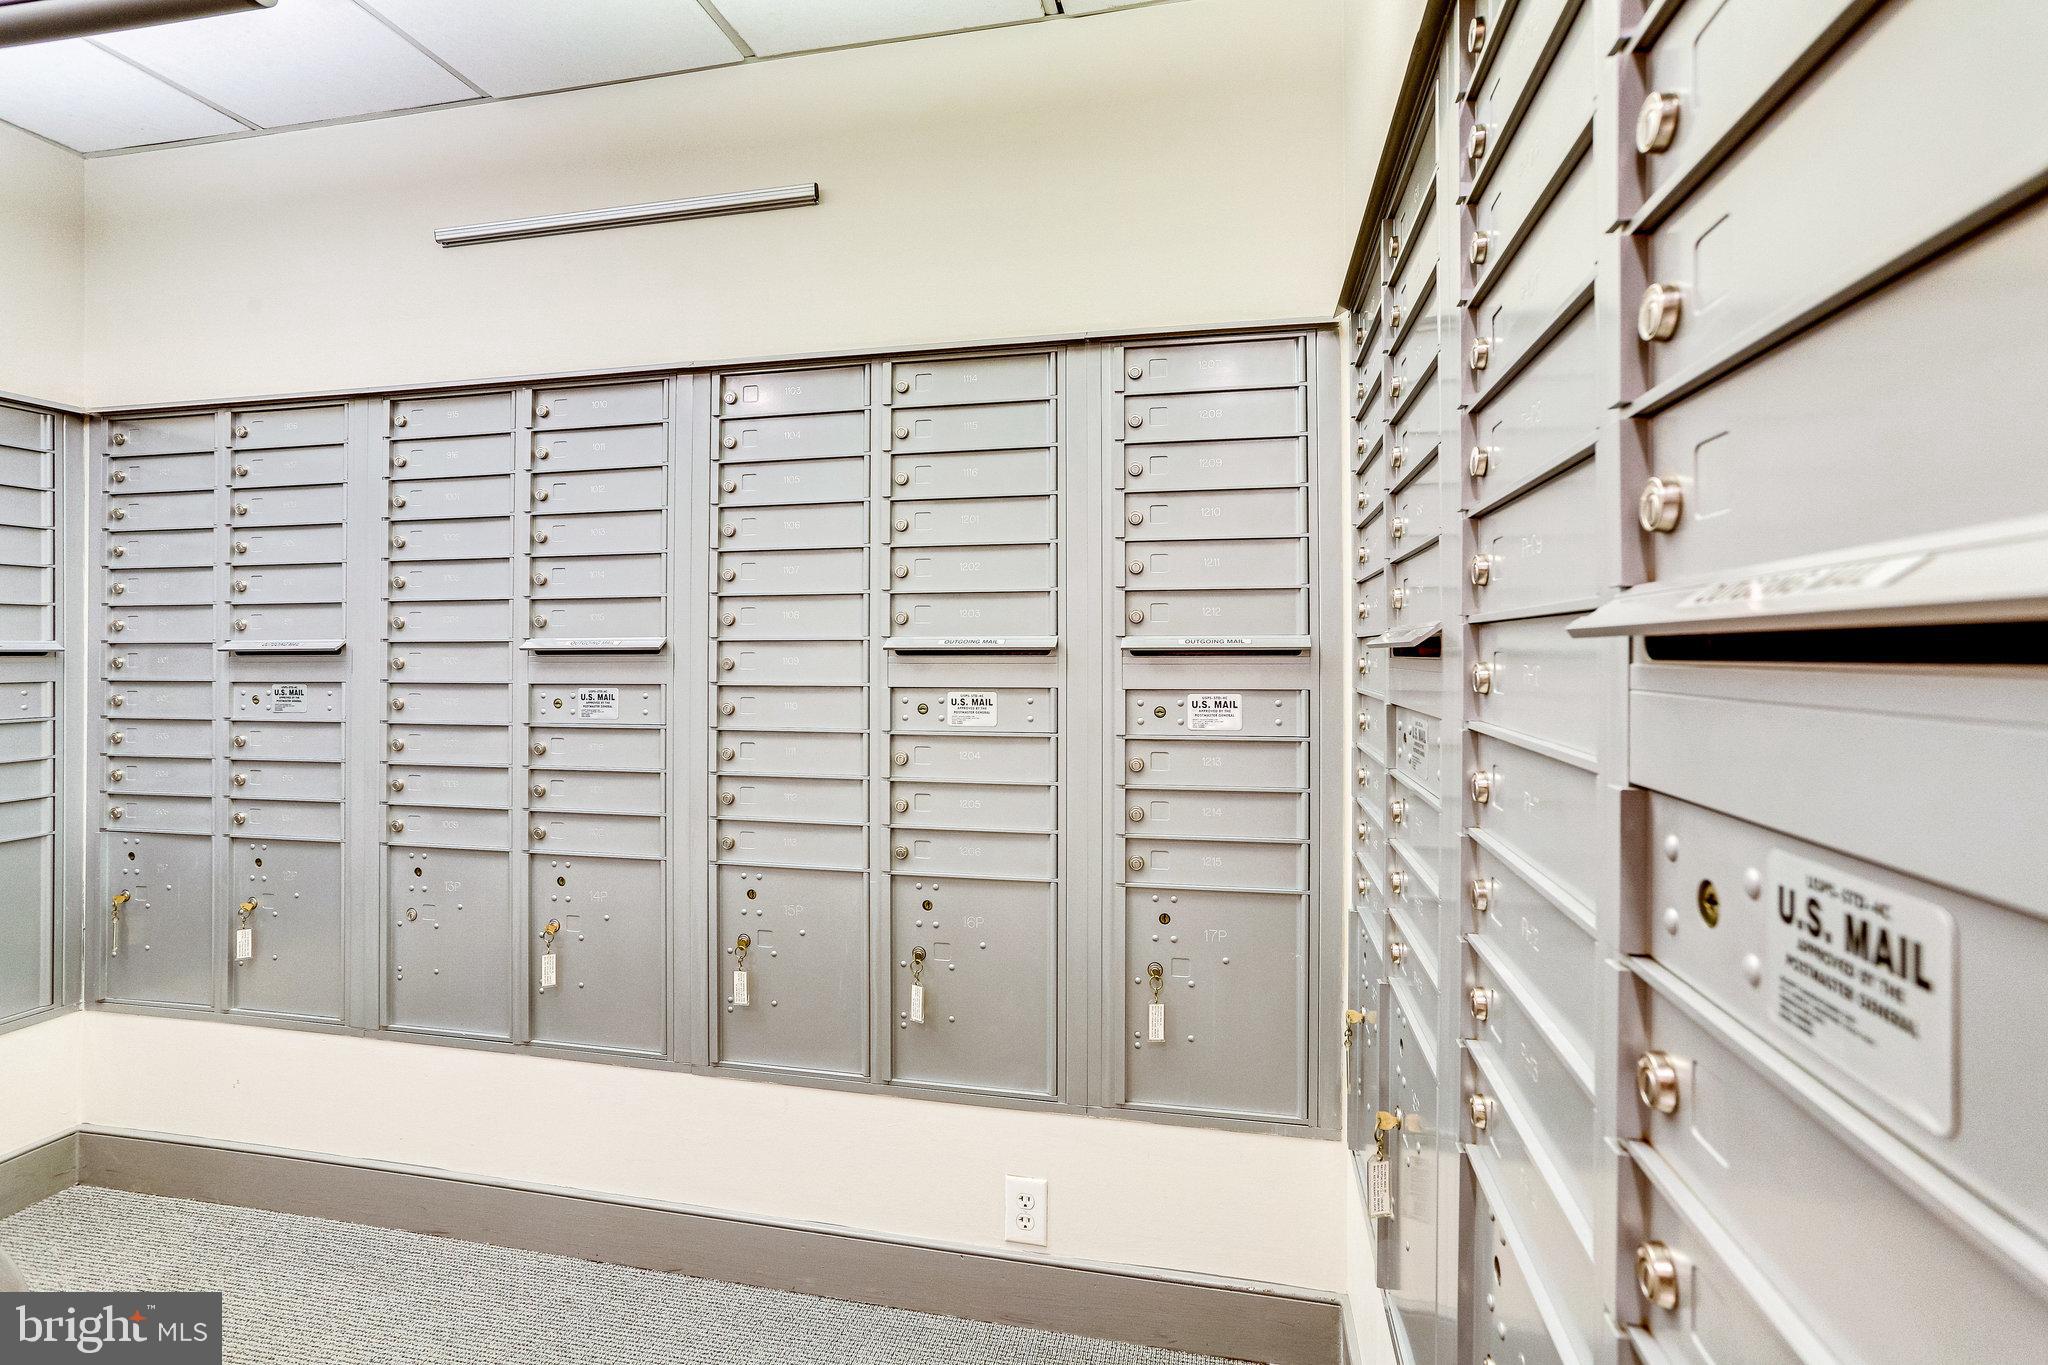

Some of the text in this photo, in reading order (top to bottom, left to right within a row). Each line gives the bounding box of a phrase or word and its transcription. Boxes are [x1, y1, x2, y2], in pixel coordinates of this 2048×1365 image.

[580, 693, 616, 701] U.S. MAIL
[951, 698, 993, 706] U.S. MAIL
[1191, 700, 1239, 709] U.S. MAIL
[962, 916, 984, 928] 16P
[1203, 929, 1228, 942] 17P
[1778, 884, 1933, 991] U.S. MAIL
